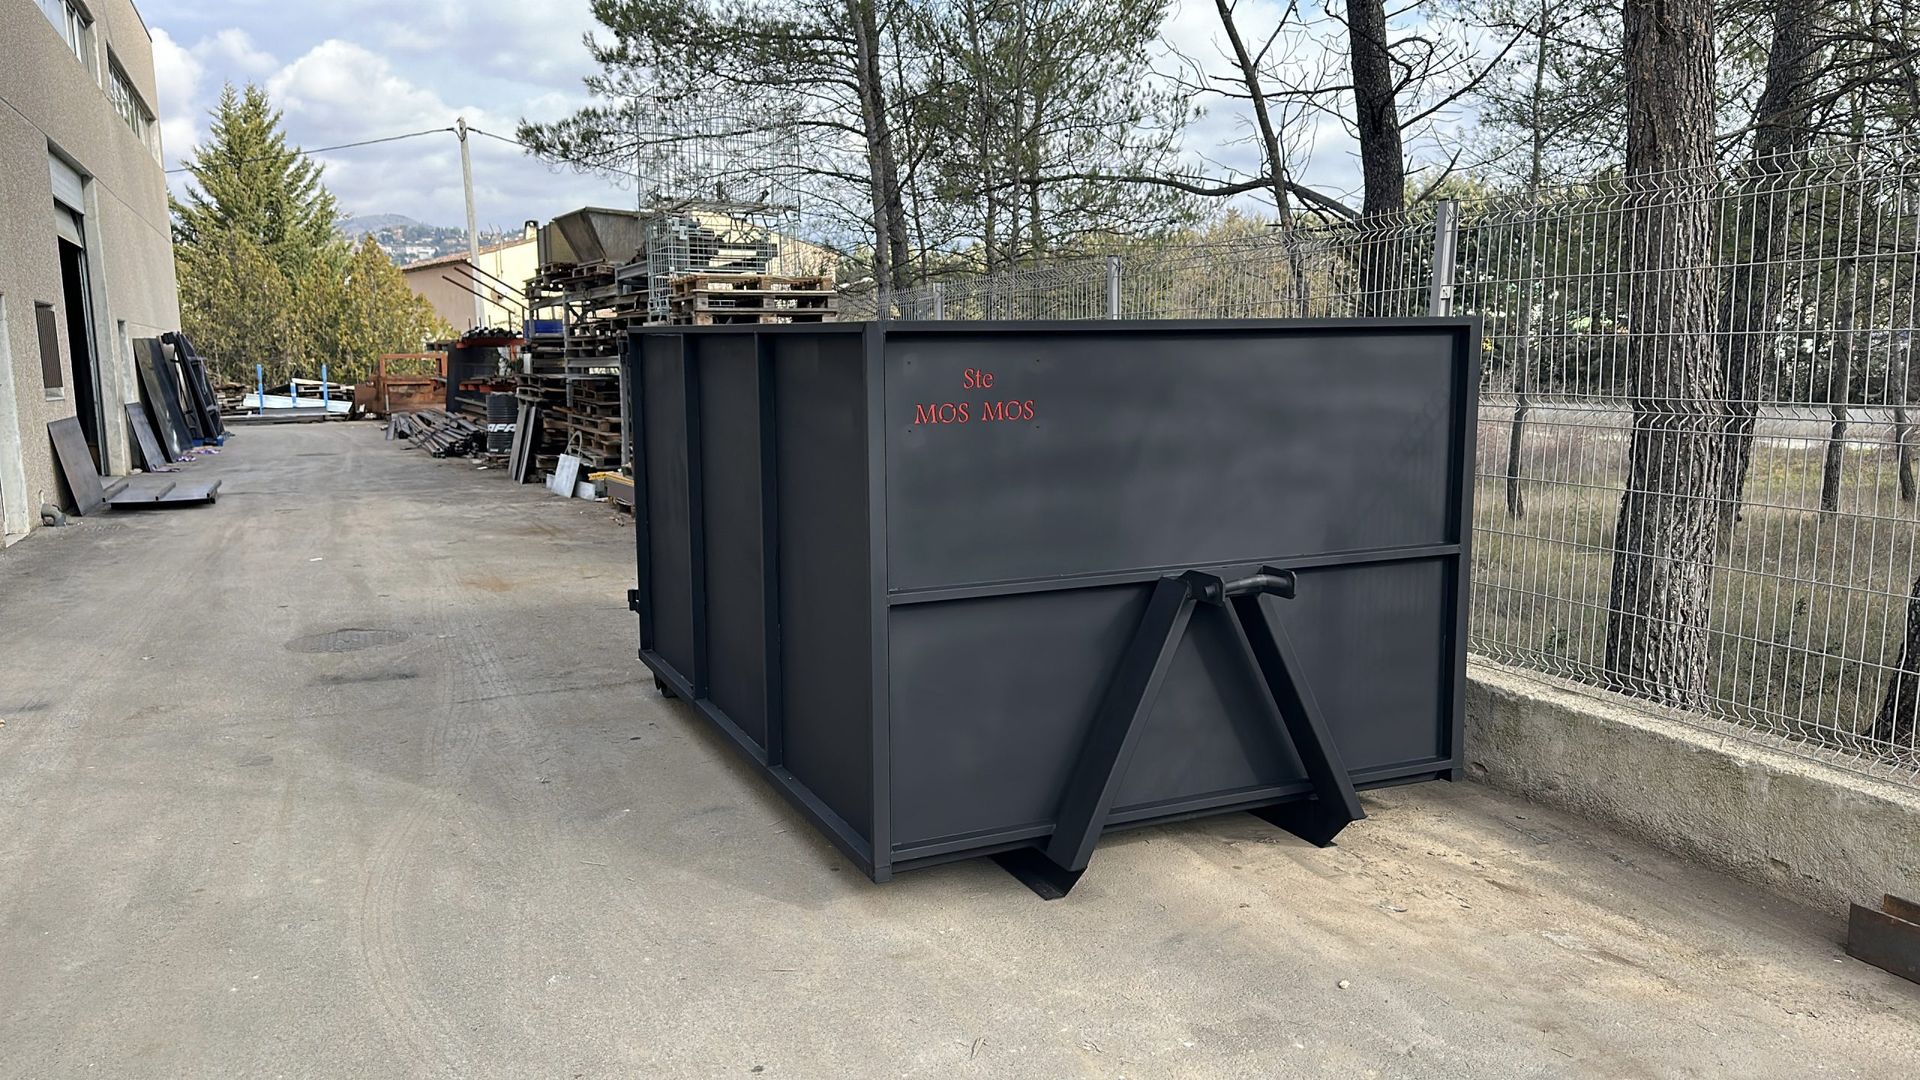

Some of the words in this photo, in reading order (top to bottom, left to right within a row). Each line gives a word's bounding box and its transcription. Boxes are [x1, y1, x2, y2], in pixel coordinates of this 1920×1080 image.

[963, 368, 993, 389] Ste
[914, 402, 970, 425] MOS
[981, 399, 1035, 422] MOS
